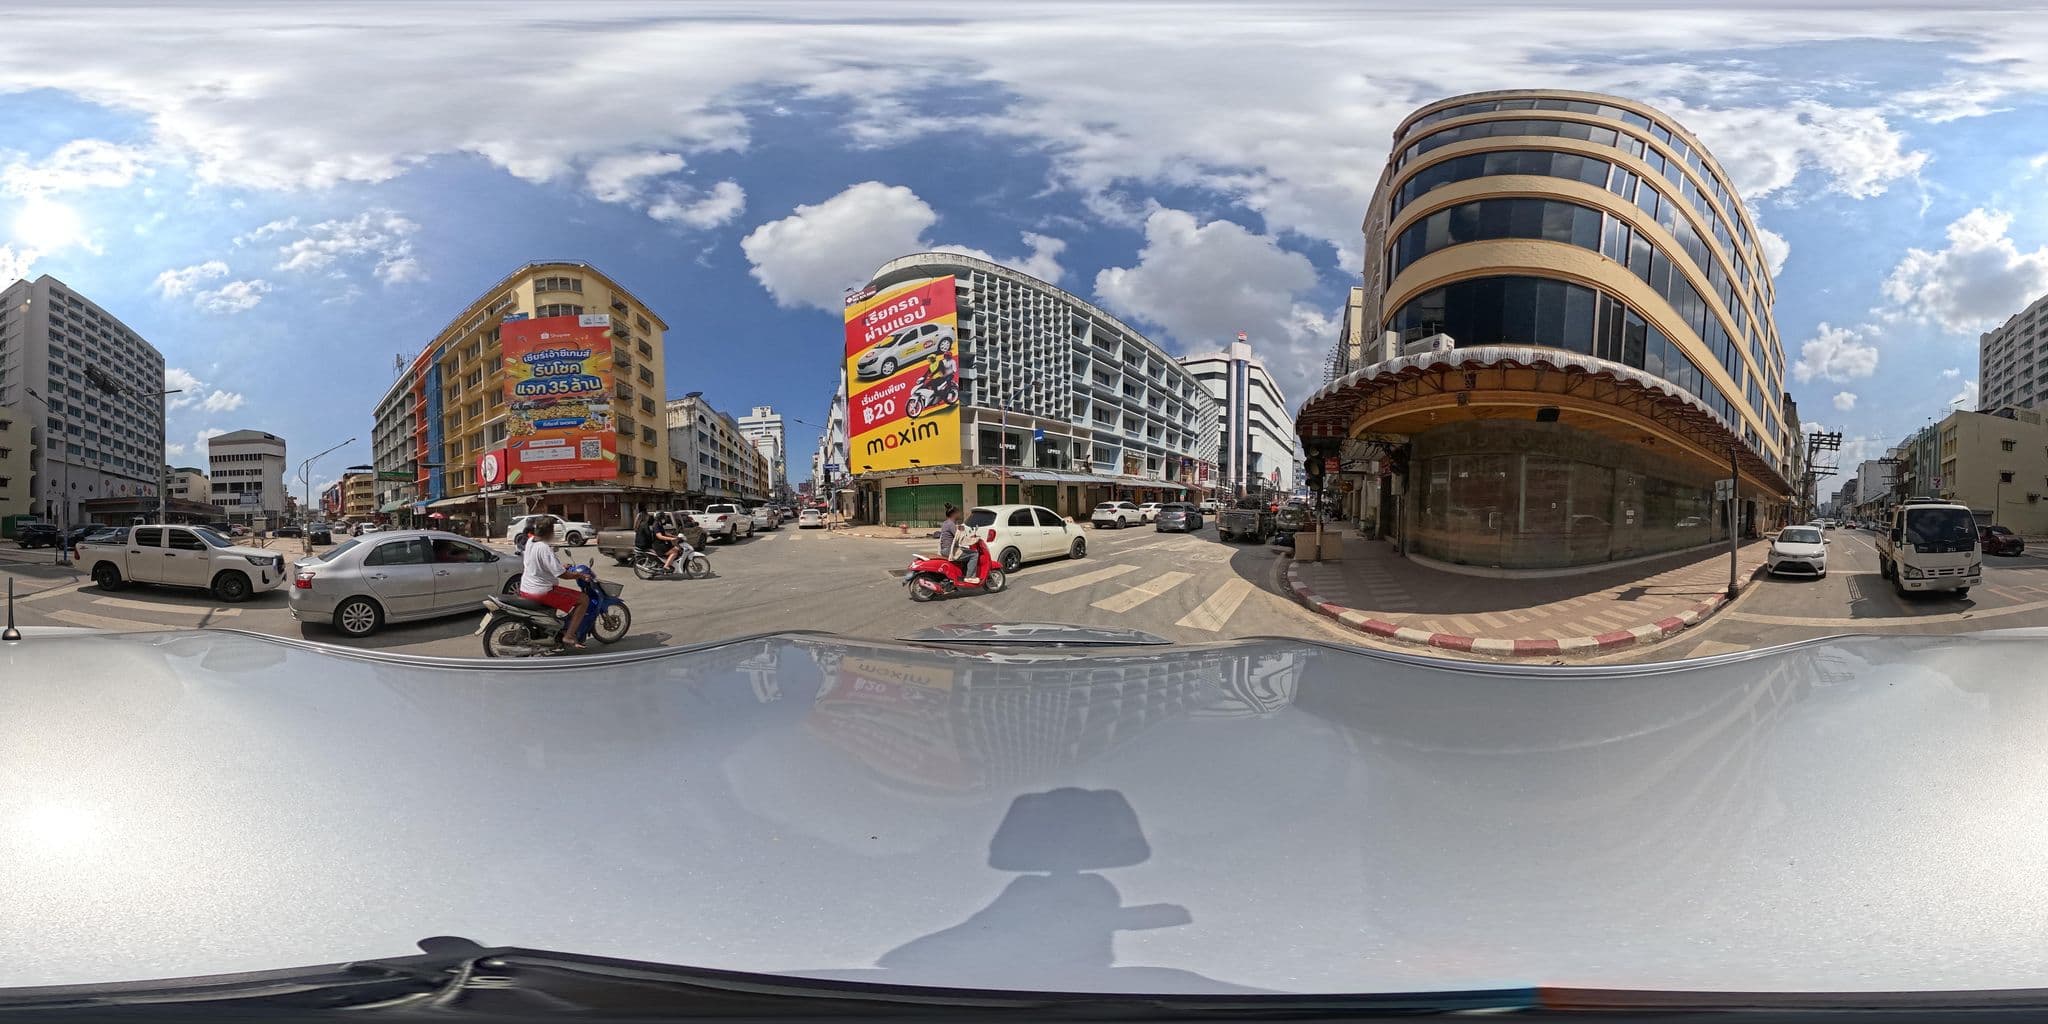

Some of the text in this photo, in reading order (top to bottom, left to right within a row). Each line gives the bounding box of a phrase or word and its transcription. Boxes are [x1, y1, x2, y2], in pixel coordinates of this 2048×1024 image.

[864, 305, 927, 342] ผ่านแอป
[865, 296, 920, 327] เรียกรถ
[523, 349, 591, 363] เชียร์เจ้าซีเกมส์
[535, 361, 580, 376] รับโชค
[517, 378, 601, 395] แจก 35 ล้าน
[861, 382, 907, 406] เริ่มต้นเพียง
[866, 421, 939, 456] maxim
